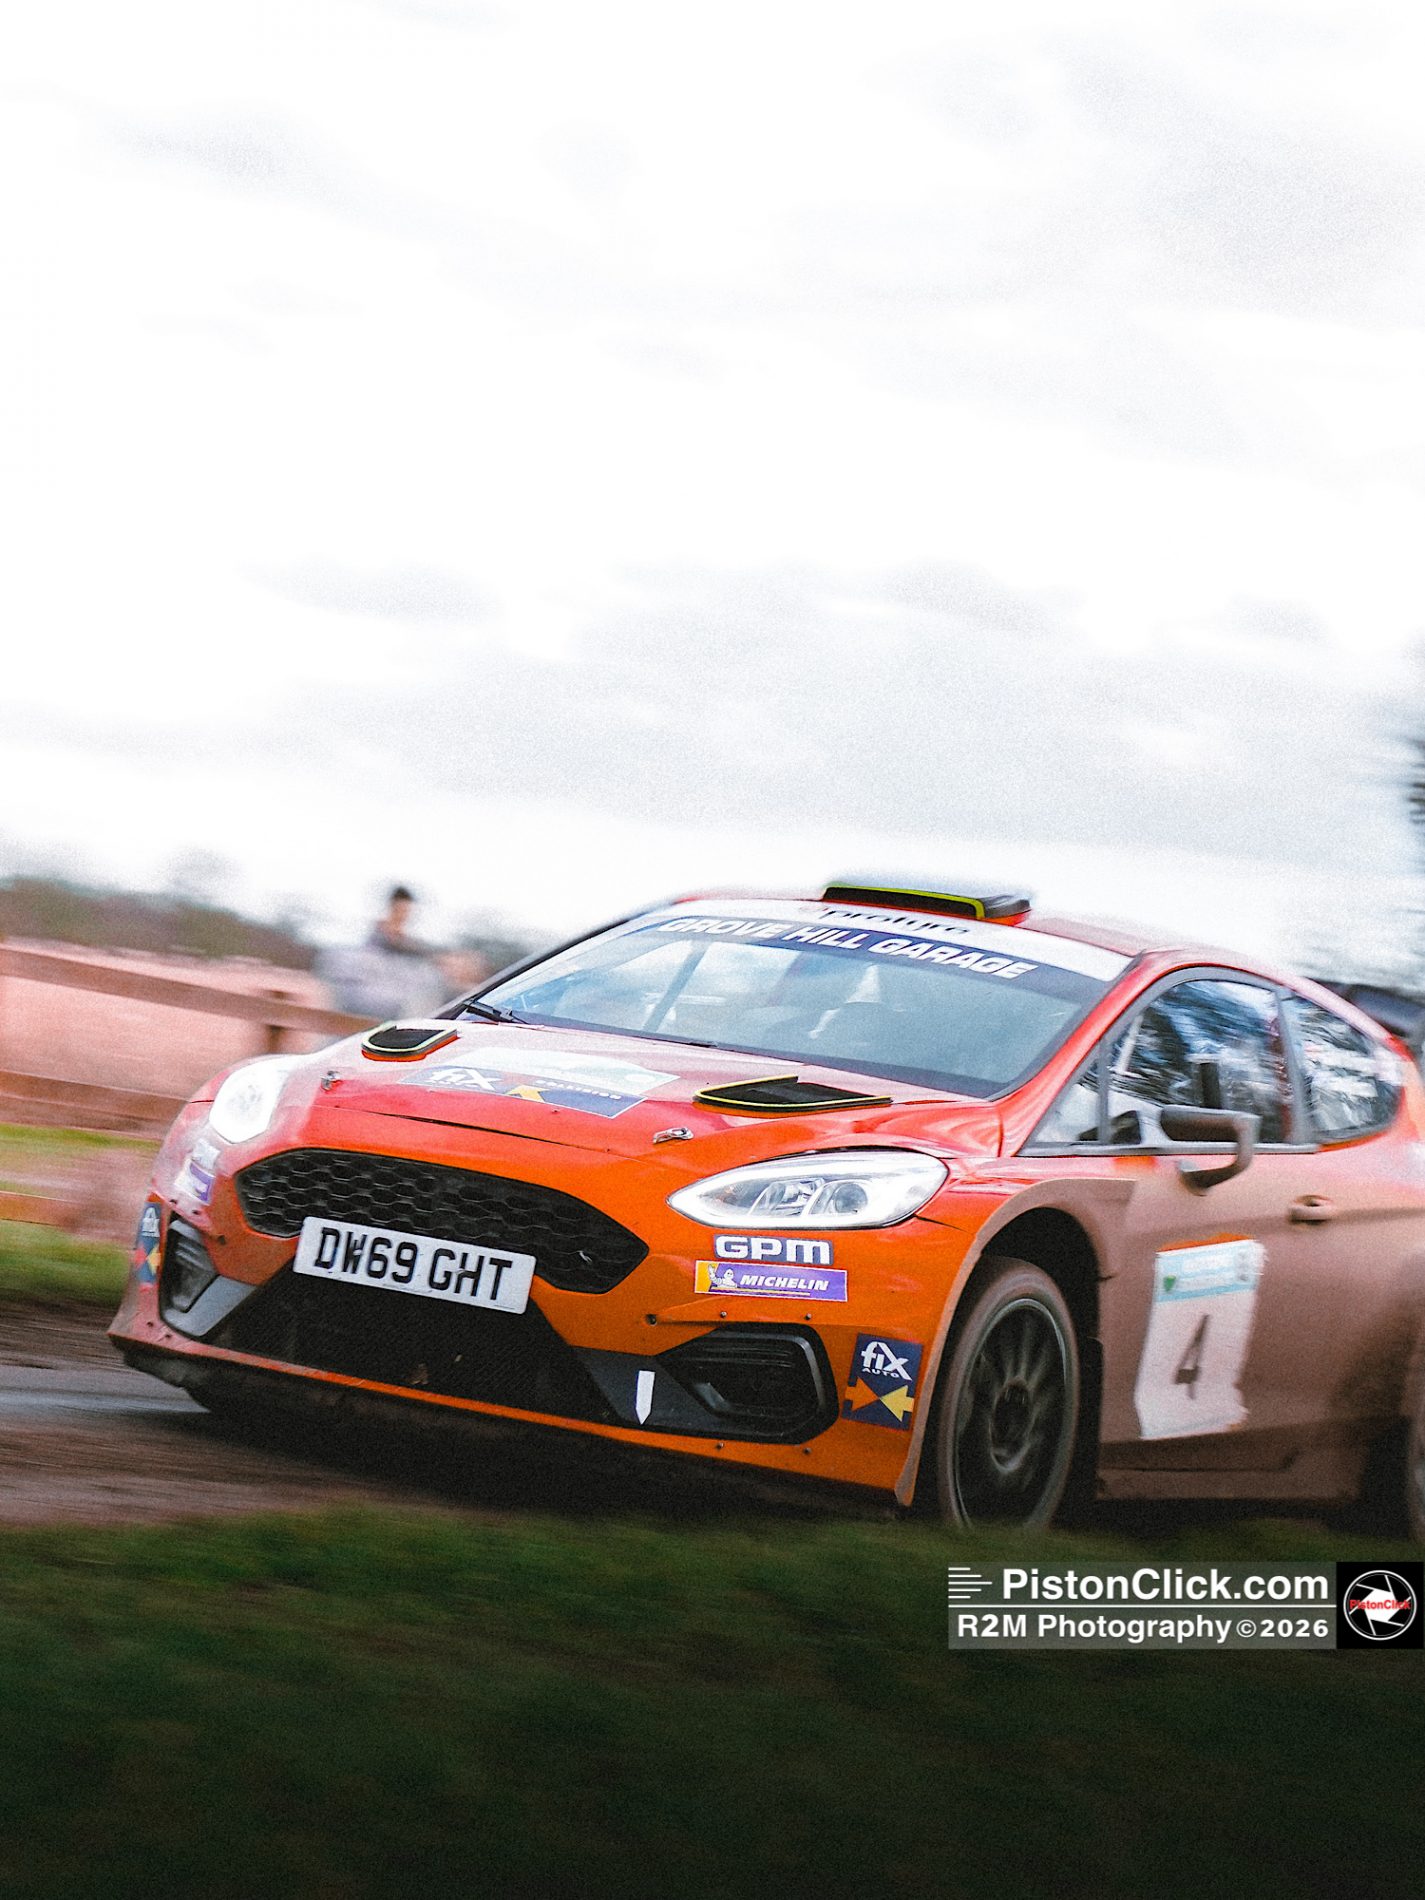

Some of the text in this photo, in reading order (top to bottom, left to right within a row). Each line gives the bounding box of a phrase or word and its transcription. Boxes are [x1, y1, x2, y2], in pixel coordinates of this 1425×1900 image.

[656, 919, 1039, 979] GROVE HILL GARAGE
[314, 1227, 513, 1301] DW69 GHT
[739, 1274, 829, 1291] MICHELIN
[862, 1367, 900, 1378] AUTO
[1174, 1313, 1210, 1400] 4
